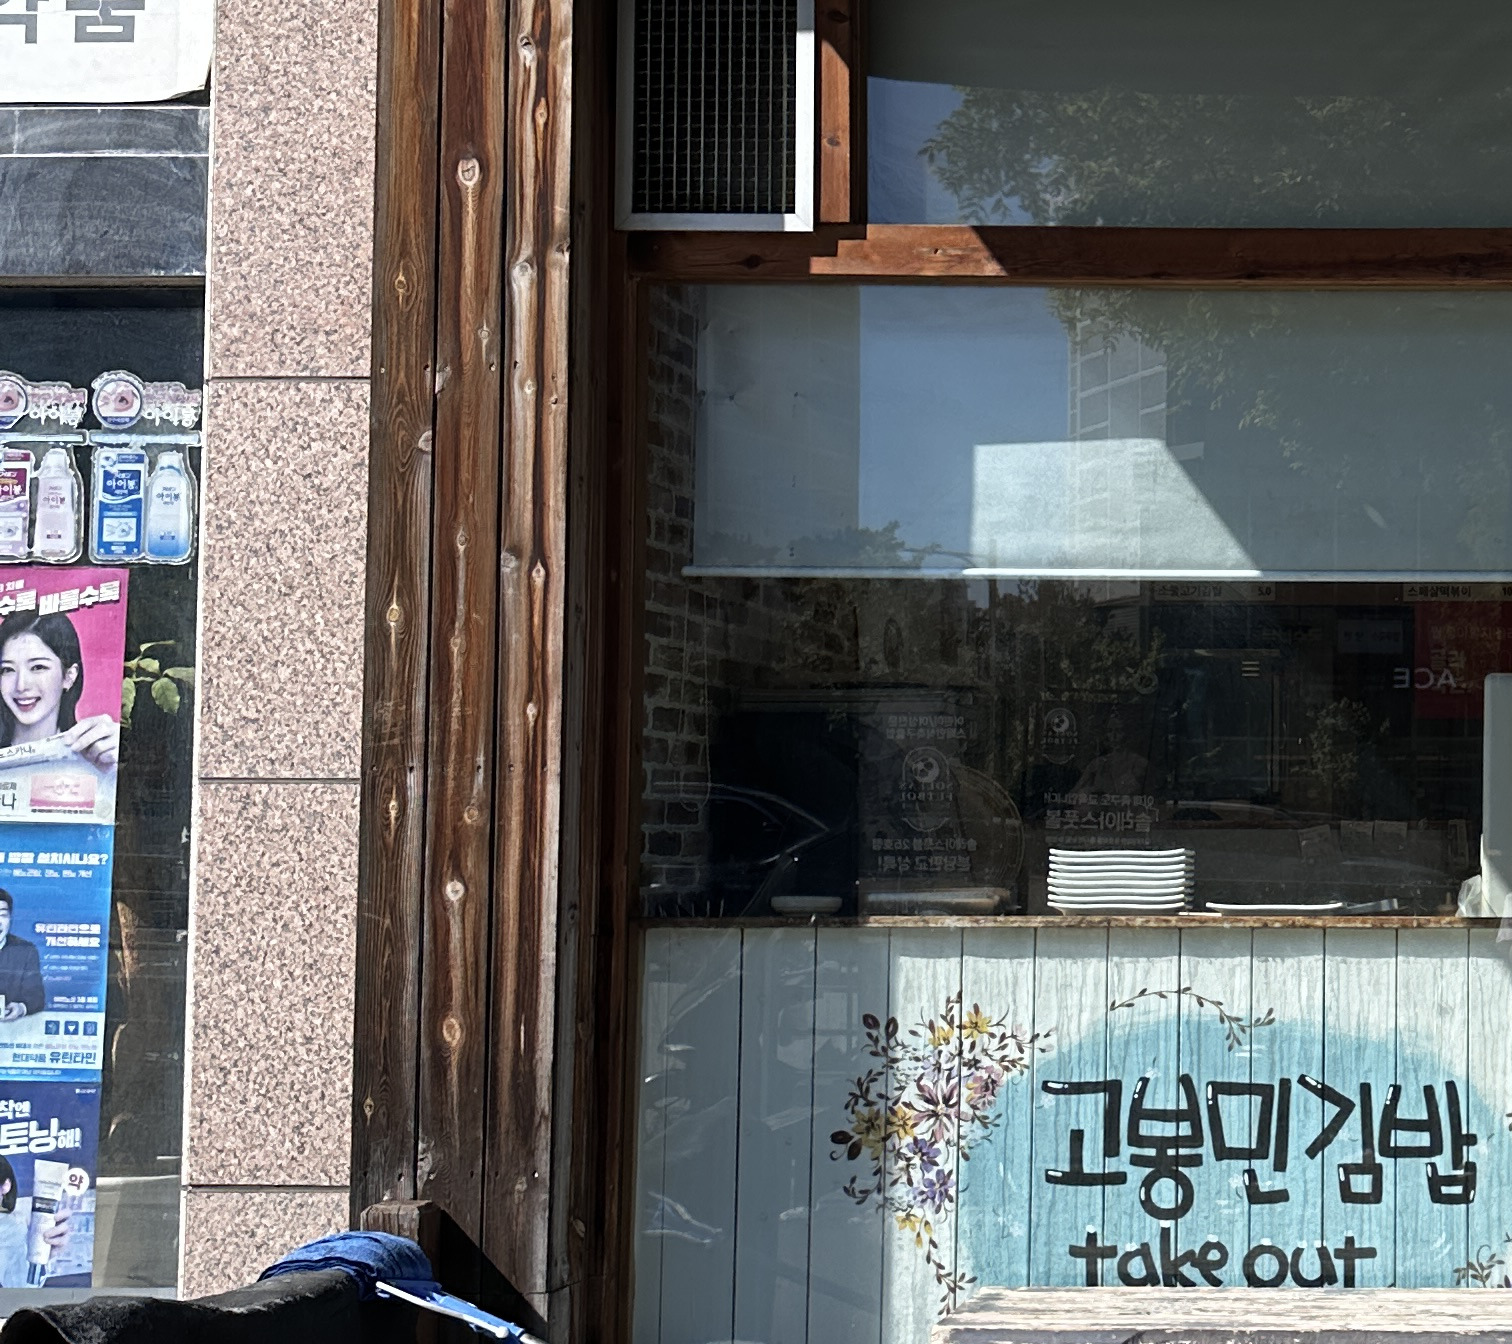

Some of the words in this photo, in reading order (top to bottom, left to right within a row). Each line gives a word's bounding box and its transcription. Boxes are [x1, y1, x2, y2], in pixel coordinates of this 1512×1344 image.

[1041, 1072, 1478, 1221] 고봉민김밥
[68, 1173, 85, 1191] 약
[1068, 1225, 1230, 1288] take
[1243, 1234, 1377, 1288] out
